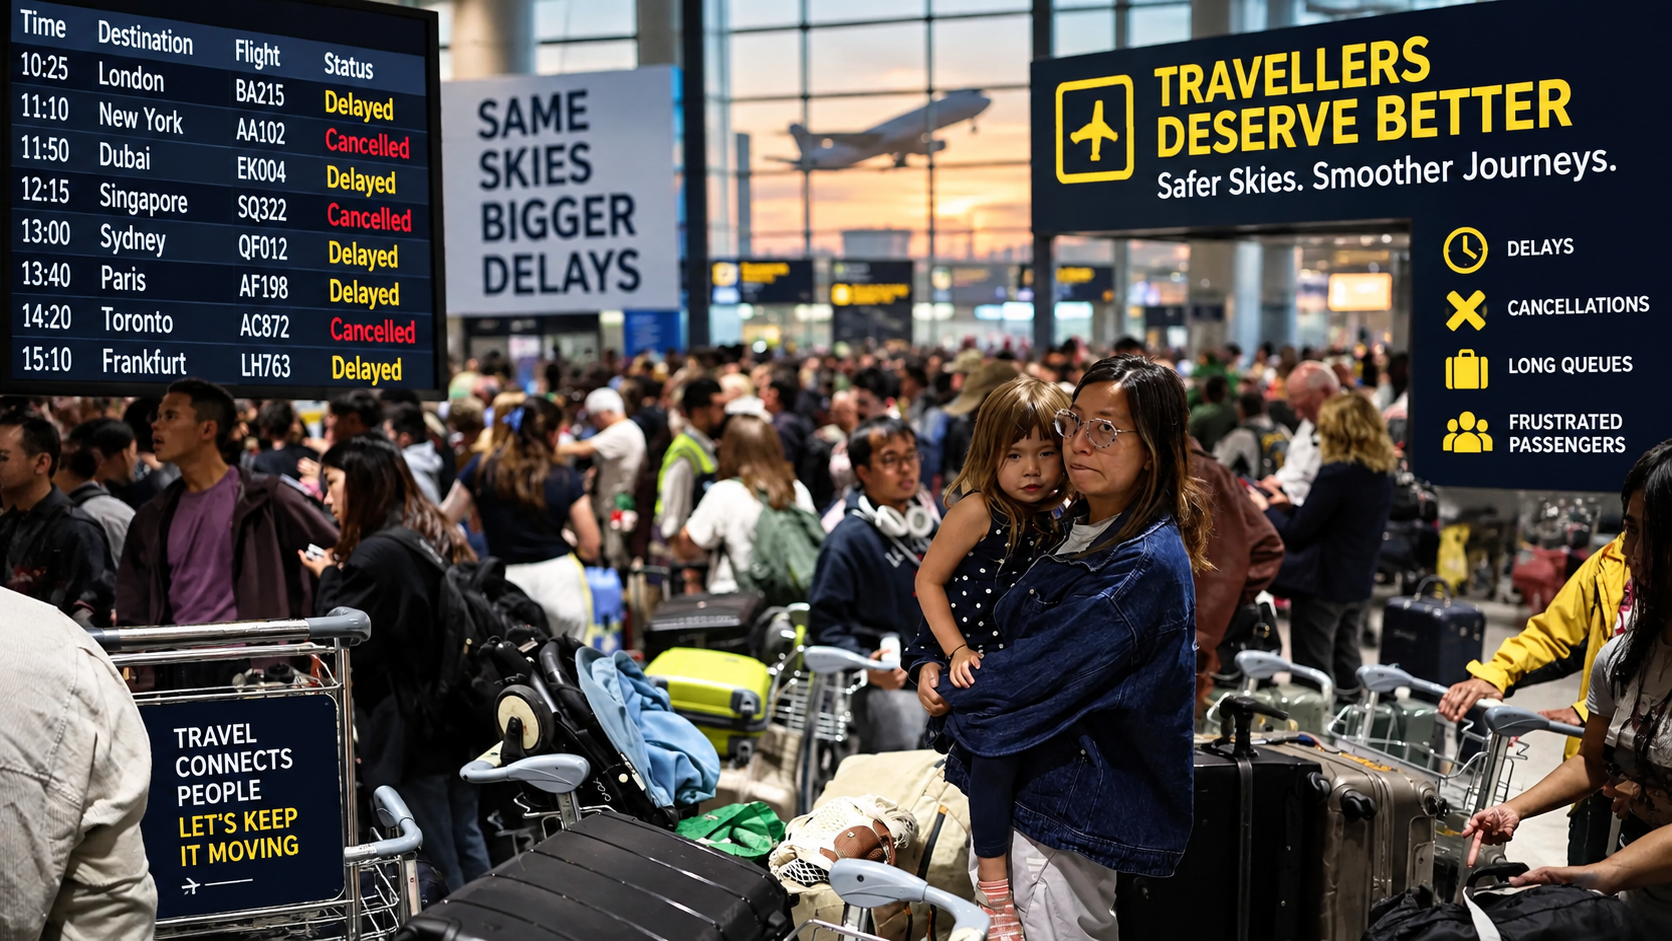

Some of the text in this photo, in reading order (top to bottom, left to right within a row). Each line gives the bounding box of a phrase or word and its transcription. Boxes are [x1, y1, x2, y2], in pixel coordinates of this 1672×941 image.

[21, 9, 66, 38] Time
[99, 20, 192, 55] Destination
[22, 52, 68, 80] 10:25
[236, 39, 280, 70] Flight
[325, 52, 373, 79] Status
[99, 61, 163, 92] London
[1154, 36, 1432, 107] TRAVELLERS
[237, 79, 284, 106] BA215
[326, 90, 393, 122] Delayed
[22, 93, 68, 121] 11:10
[100, 102, 183, 134] New York
[478, 89, 589, 140] SAME
[1158, 78, 1573, 157] DESERVE BETTER
[237, 118, 285, 144] AA102
[326, 128, 409, 158] Cancelled
[22, 135, 69, 162] 11:50
[100, 142, 149, 169] Dubai
[238, 157, 286, 182] EK004
[479, 142, 592, 191] SKIES
[1158, 150, 1617, 199] Safer Skies. Smoother Journeys.
[22, 176, 69, 203] 12:15
[327, 165, 395, 197] Delayed
[100, 183, 187, 216] Singapore
[238, 195, 286, 222] SQ322
[328, 203, 411, 232] Cancelled
[482, 193, 636, 242] BIGGER
[22, 219, 70, 245] 13:00
[101, 224, 166, 257] Sydney
[239, 235, 287, 260] QF012
[329, 241, 398, 271] Delayed
[1508, 238, 1573, 256] DELAYS
[22, 261, 70, 287] 13:40
[102, 265, 146, 291] Paris
[483, 248, 641, 296] DELAYS
[240, 274, 288, 299] AF198
[330, 279, 399, 309] Delayed
[23, 303, 71, 329] 14:20
[1508, 296, 1649, 315] CANCELLATIONS
[102, 307, 173, 333] Toronto
[241, 314, 289, 338] AC872
[331, 317, 415, 343] Cancelled
[23, 346, 71, 371] 15:10
[103, 349, 186, 374] Frankfurt
[242, 354, 290, 377] LH763
[333, 356, 401, 385] Delayed
[1509, 356, 1633, 374] LONG QUEUES
[1510, 414, 1622, 430] FRUSTRATED
[1510, 437, 1625, 453] PASSENGERS
[174, 723, 258, 749] TRAVEL
[176, 748, 293, 778] CONNECTS
[178, 779, 261, 806] PEOPLE
[180, 808, 297, 837] LET'S KEEP
[181, 835, 298, 866] IT MOVING
